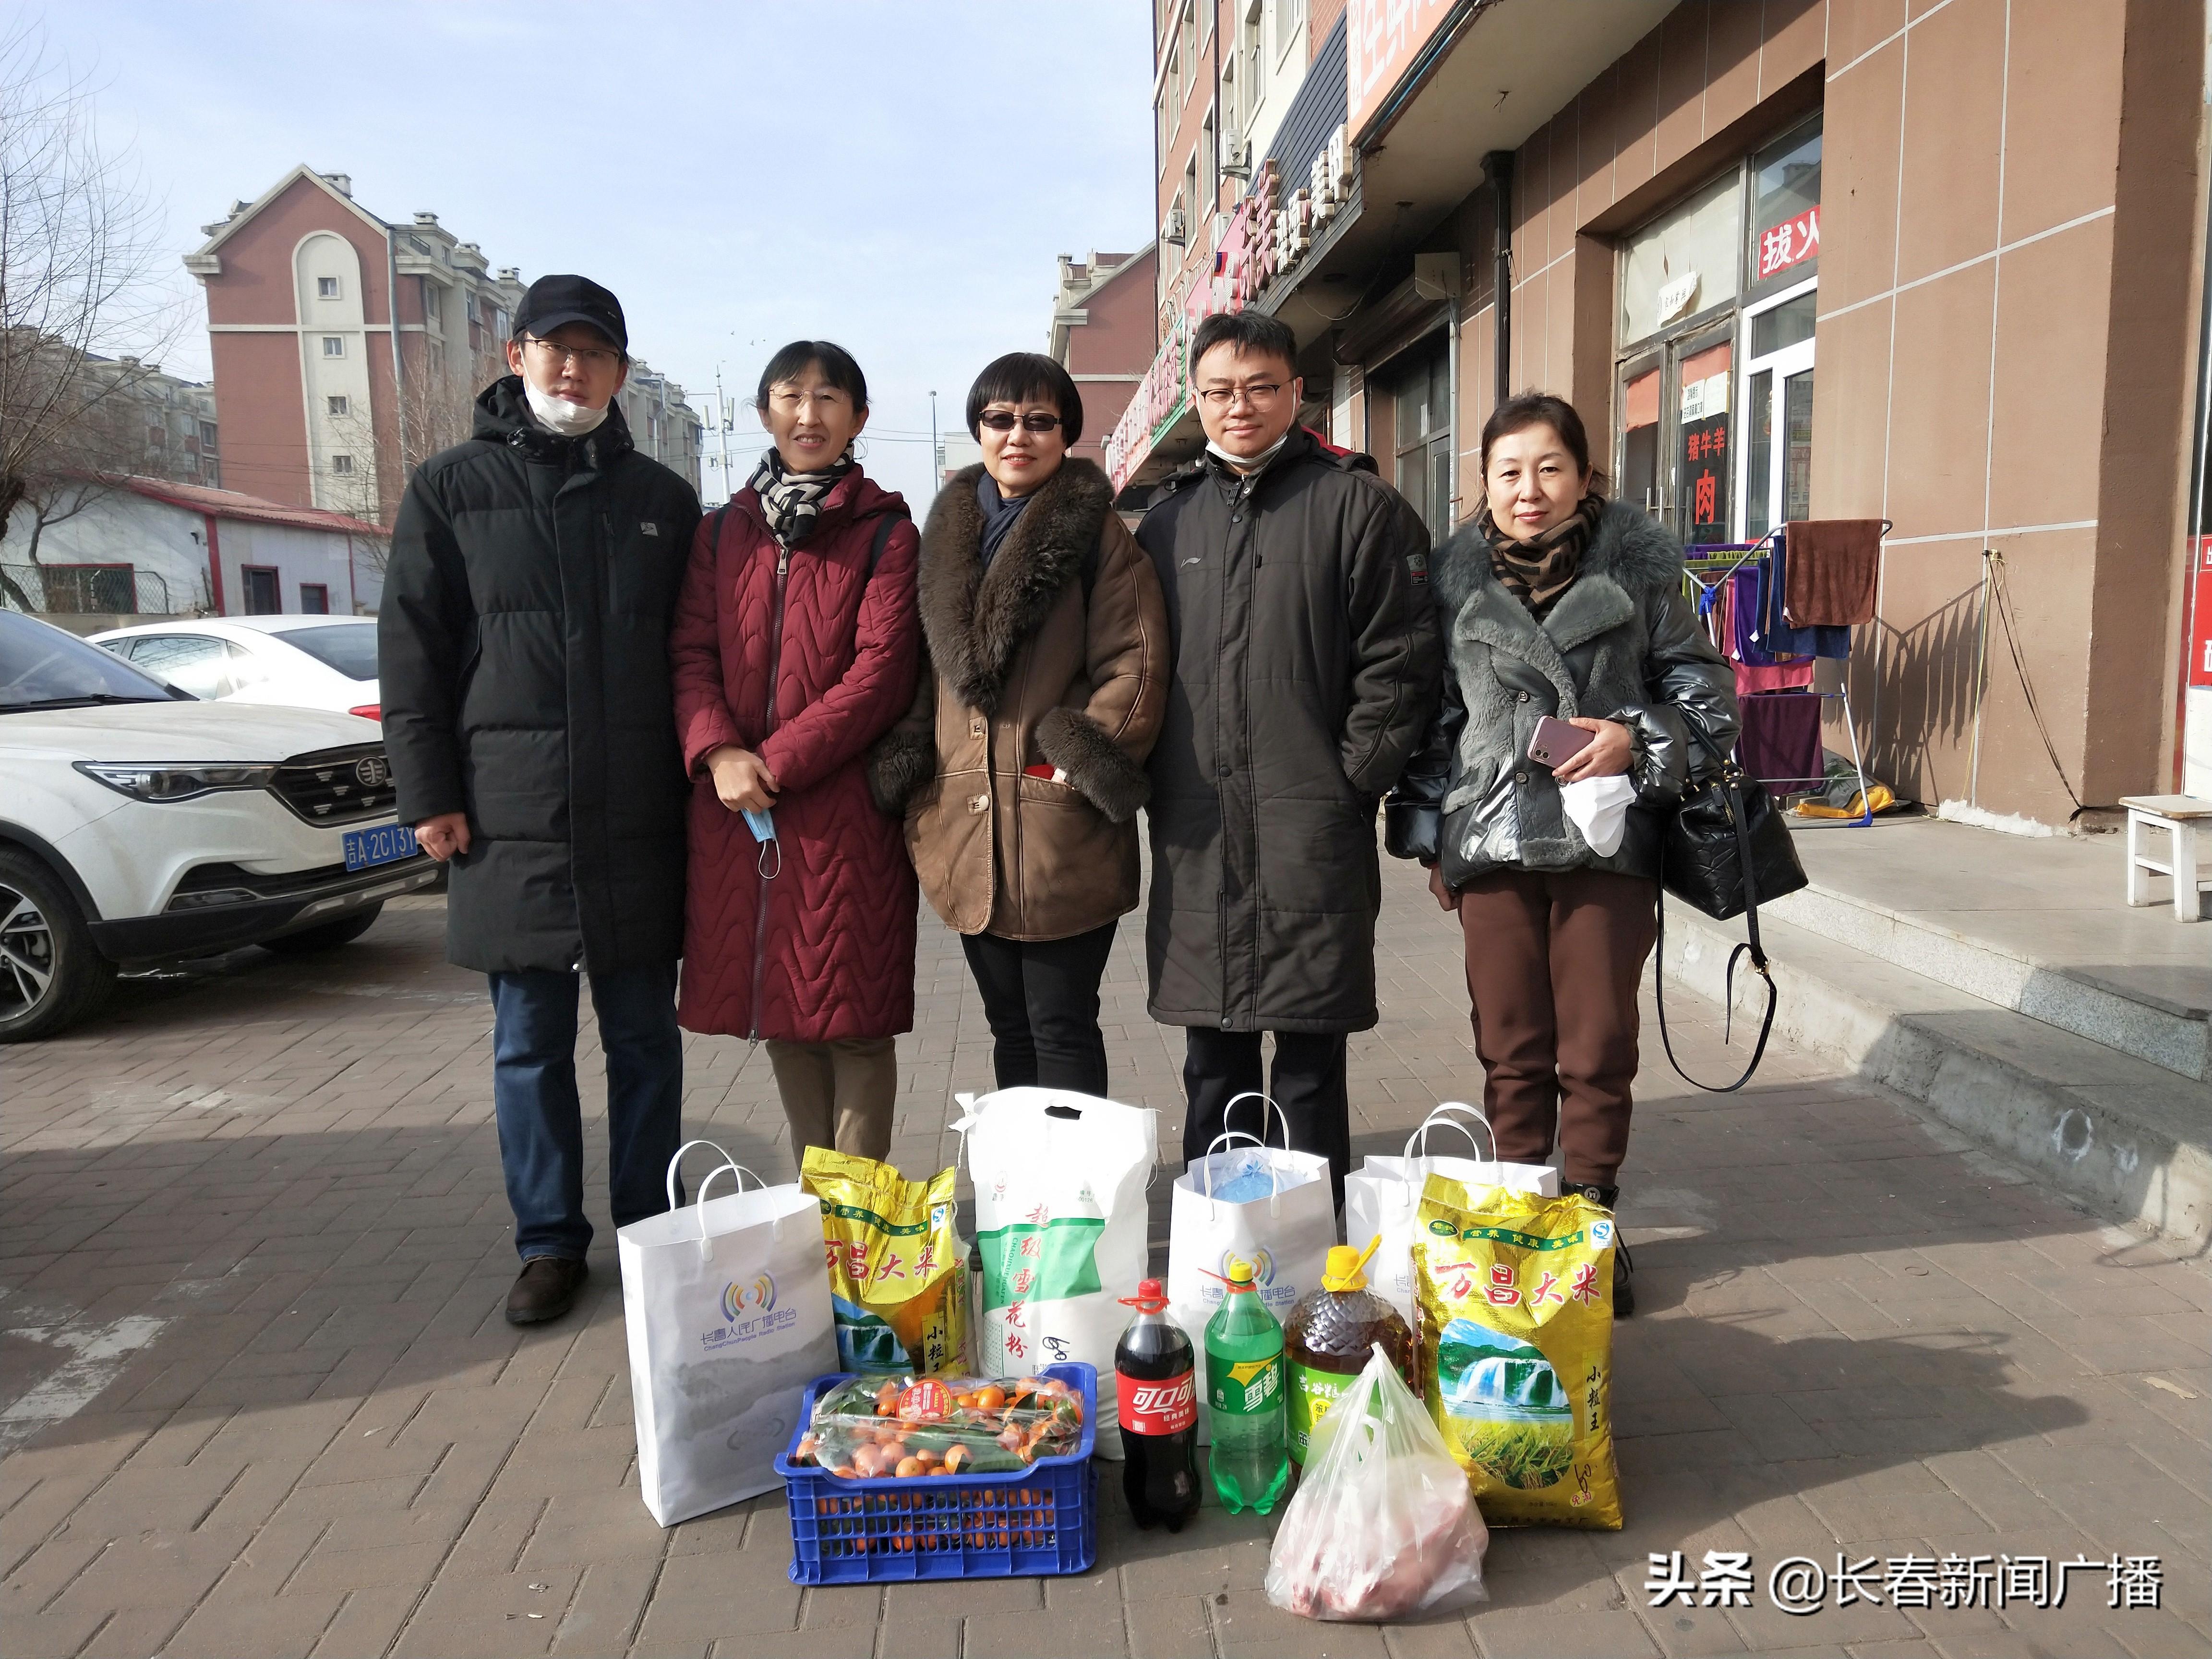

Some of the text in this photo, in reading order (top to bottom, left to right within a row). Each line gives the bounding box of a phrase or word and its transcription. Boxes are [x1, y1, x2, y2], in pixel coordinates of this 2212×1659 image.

[1688, 426, 1725, 462] 猪牛羊
[1695, 469, 1715, 525] 肉
[1470, 1229, 1578, 1249] 营养 健康 美味
[1005, 1203, 1049, 1359] 超级雪花粉
[1434, 1262, 1601, 1307] 万昌大米
[700, 1308, 796, 1345] 长春人民广播电台
[758, 1328, 774, 1336] Radio
[776, 1322, 795, 1331] Station
[1243, 1363, 1280, 1412] 雪碧
[1586, 1366, 1601, 1432] 小粒王
